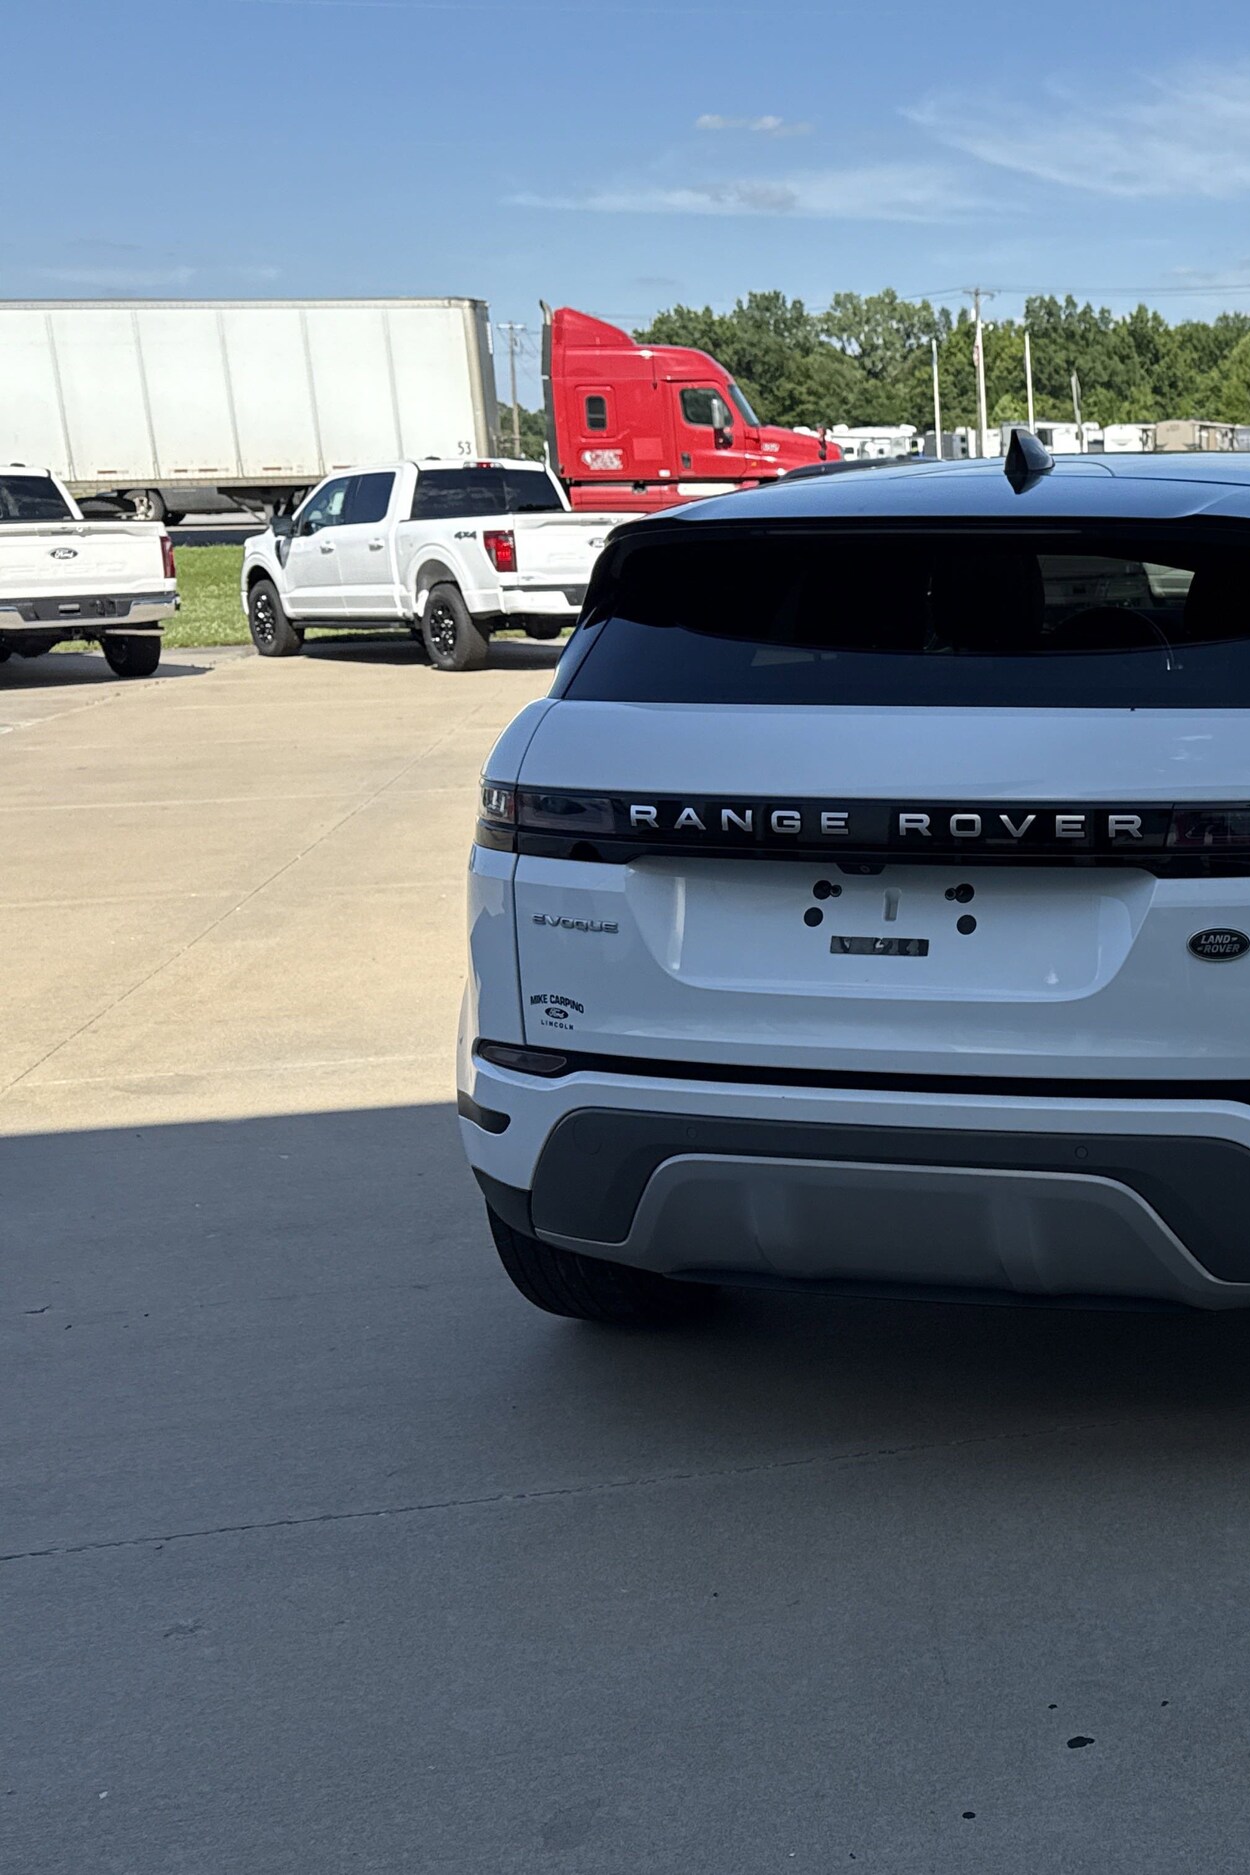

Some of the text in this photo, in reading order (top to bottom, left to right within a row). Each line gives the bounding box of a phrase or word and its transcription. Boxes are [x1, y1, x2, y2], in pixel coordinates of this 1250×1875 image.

[457, 440, 472, 456] 53
[629, 804, 1143, 838] RANGE ROVER
[532, 913, 619, 934] EVOQUE
[1200, 934, 1231, 944] LAND
[1203, 943, 1240, 953] ROVER
[530, 993, 585, 1014] MIKE CARPINO
[541, 1019, 574, 1031] LINCOLN
